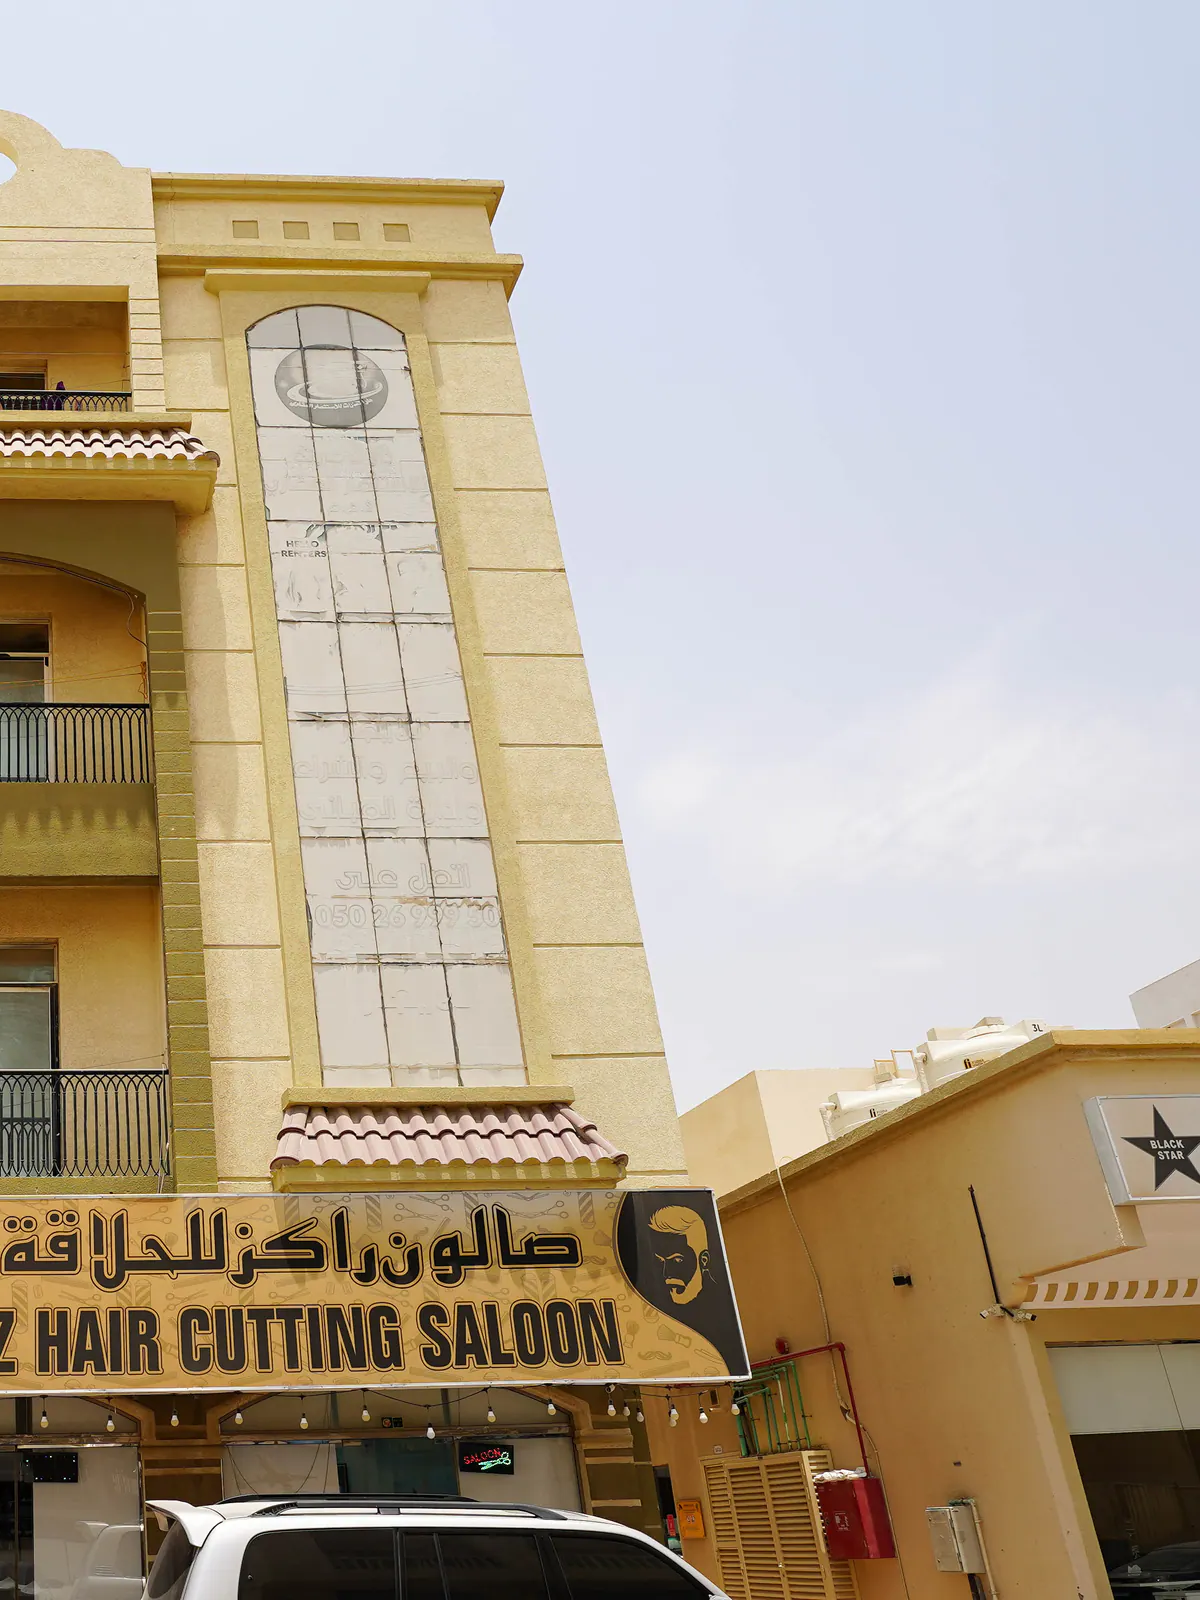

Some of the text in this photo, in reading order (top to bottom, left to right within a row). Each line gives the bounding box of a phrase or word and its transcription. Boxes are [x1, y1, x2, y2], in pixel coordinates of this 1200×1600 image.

[314, 904, 367, 928] 050
[371, 904, 406, 929] 26
[1149, 1139, 1185, 1149] BLACK
[1157, 1150, 1185, 1160] STAR
[1, 1208, 228, 1293] للحلاقة
[379, 1203, 584, 1289] صالون
[35, 1306, 162, 1376] HAIR
[177, 1301, 405, 1375] CUTTING
[416, 1297, 625, 1372] SALOON
[463, 1447, 501, 1465] SALOON
